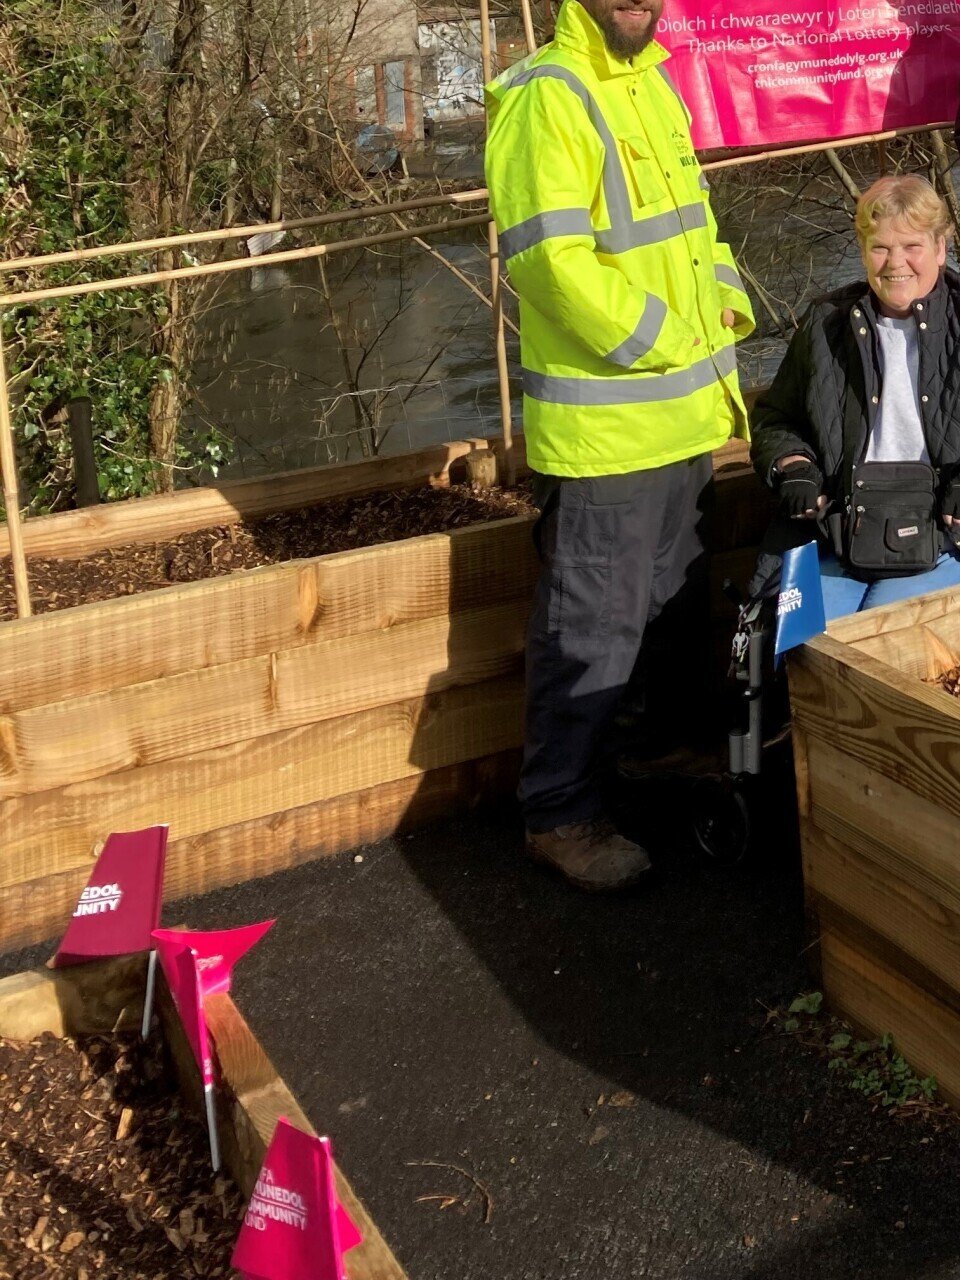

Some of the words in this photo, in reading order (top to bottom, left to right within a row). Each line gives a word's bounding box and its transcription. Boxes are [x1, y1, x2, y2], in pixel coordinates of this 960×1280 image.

[657, 15, 706, 32] Diolch
[711, 14, 716, 30] i
[720, 11, 823, 30] chwaraewyr
[827, 10, 835, 27] y
[688, 35, 744, 53] Thanks
[750, 36, 767, 49] to
[772, 29, 842, 47] National
[847, 27, 900, 42] Lottery
[747, 48, 904, 74] cronfagymunedolylg.org.uk
